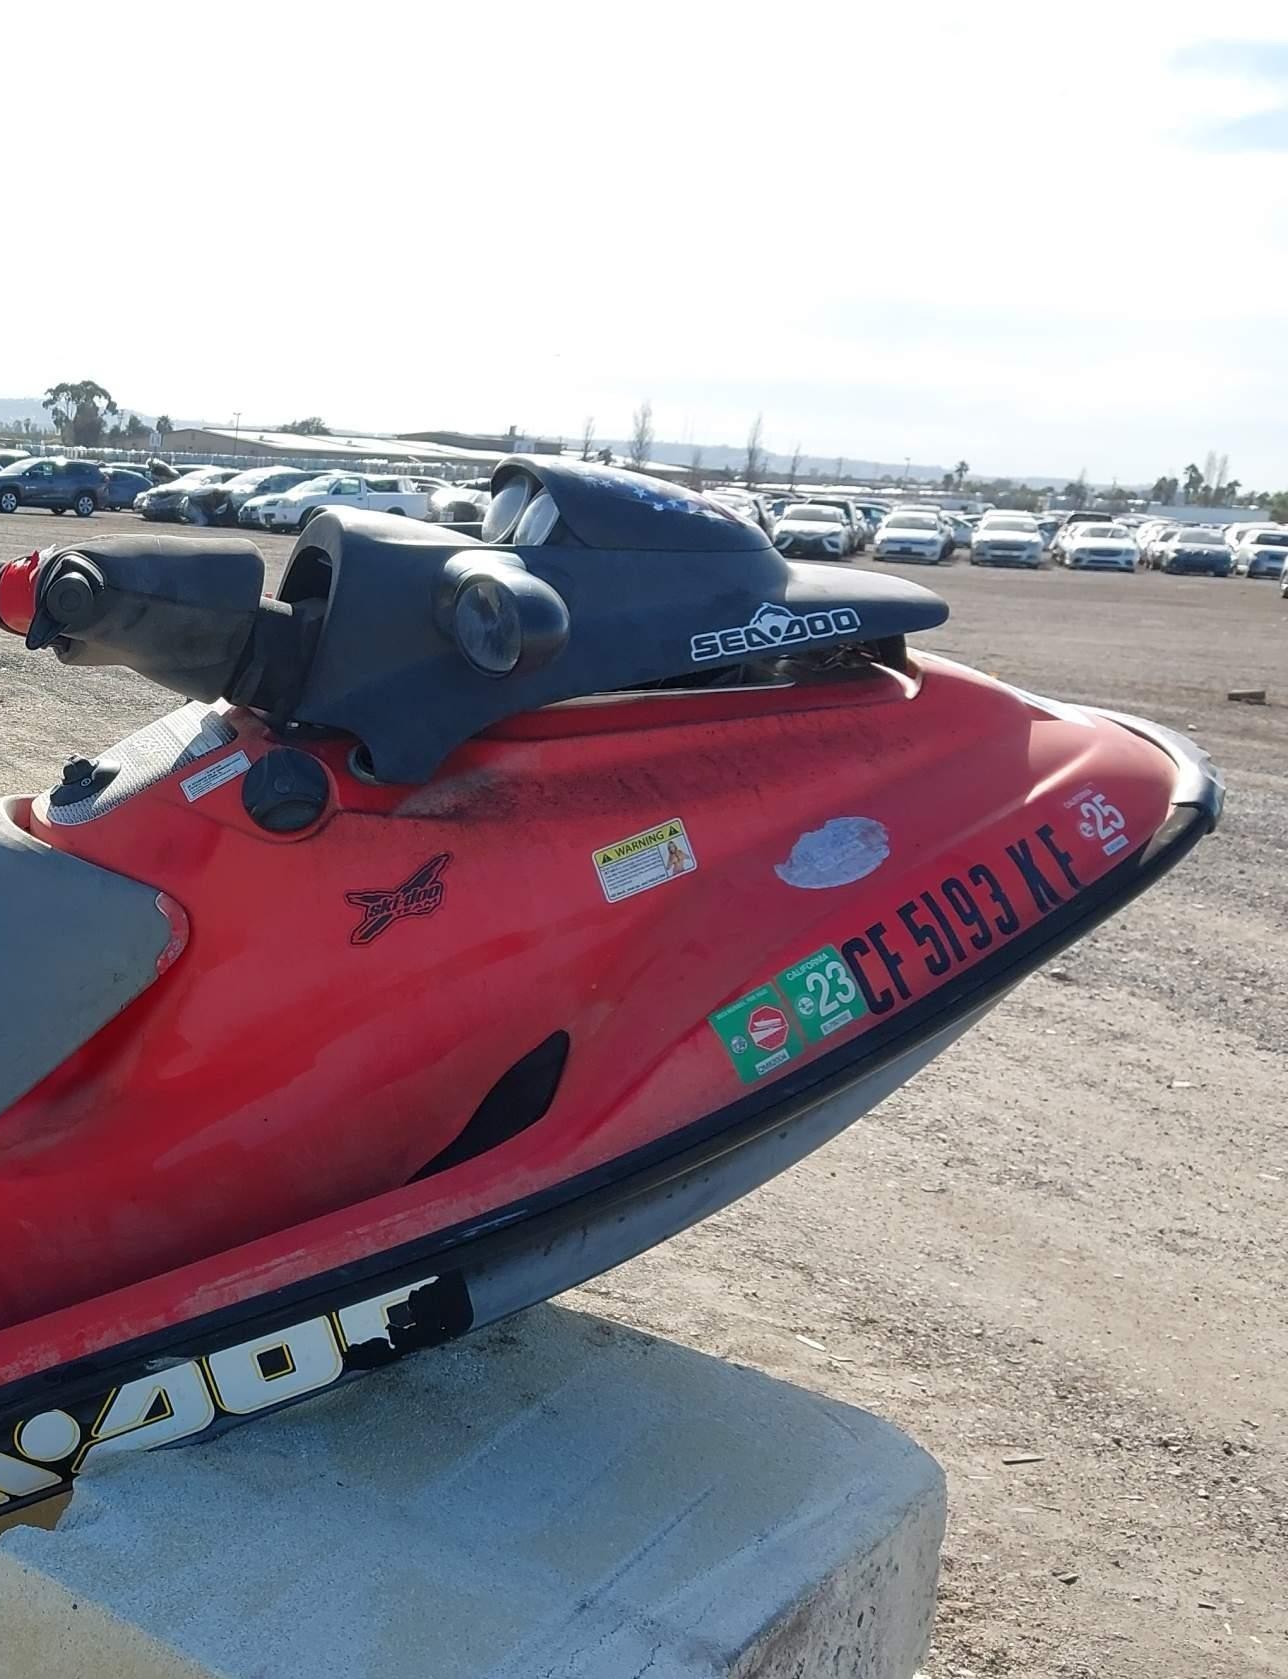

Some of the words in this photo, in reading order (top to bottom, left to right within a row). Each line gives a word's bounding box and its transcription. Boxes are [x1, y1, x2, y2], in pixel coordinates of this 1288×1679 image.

[1080, 793, 1125, 840] 25
[614, 830, 664, 857] WARNING
[841, 922, 912, 1015] CF
[896, 864, 1020, 976] 5193
[786, 953, 829, 981] CALIFORNIA
[806, 961, 856, 1017] 23
